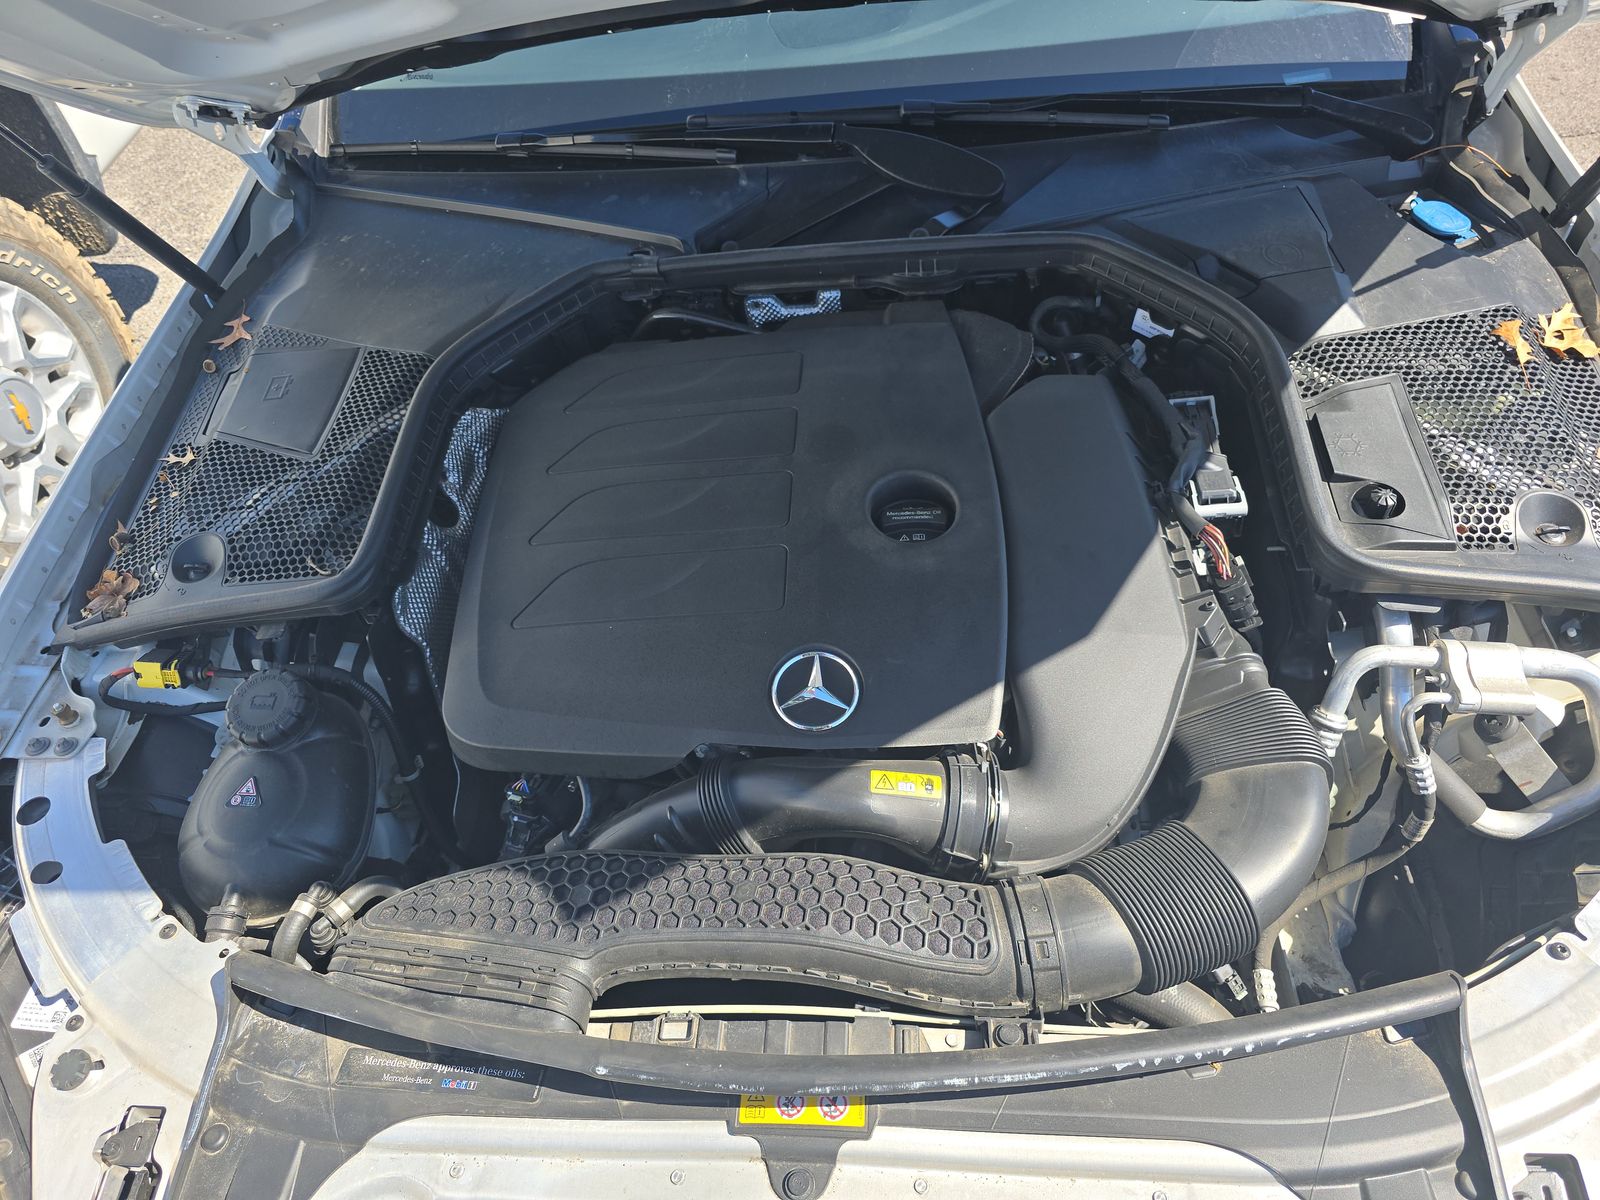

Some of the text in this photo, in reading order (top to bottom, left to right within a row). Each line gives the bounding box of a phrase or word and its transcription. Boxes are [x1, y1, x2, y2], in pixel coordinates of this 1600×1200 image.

[362, 1055, 526, 1079] Mercedes-Benz approves these oils:
[381, 1073, 433, 1085] Mercedes-Benz
